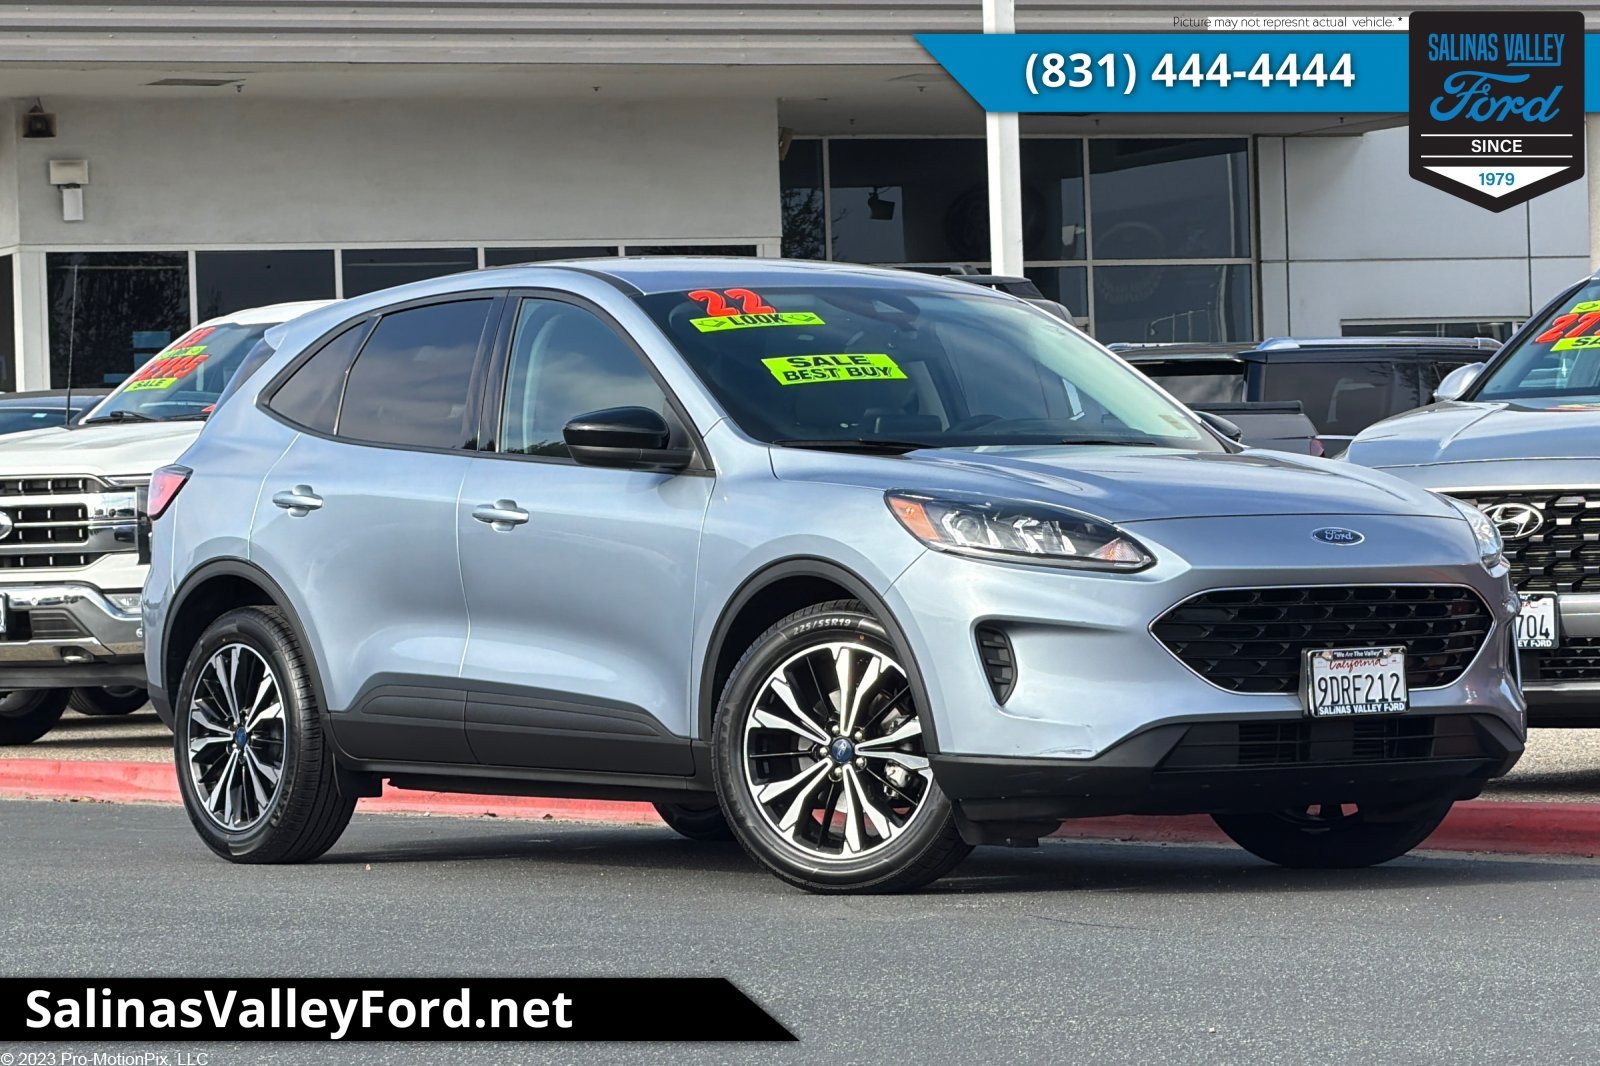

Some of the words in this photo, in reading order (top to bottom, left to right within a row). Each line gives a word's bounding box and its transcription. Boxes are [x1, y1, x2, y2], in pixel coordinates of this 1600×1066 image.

[688, 288, 777, 317] 22
[727, 313, 786, 326] LOOK
[1535, 310, 1600, 343] 27
[786, 355, 872, 368] SALE
[783, 367, 841, 381] BEST
[848, 366, 892, 378] BUY
[133, 379, 167, 389] SALE
[1325, 529, 1354, 541] Ford
[793, 618, 852, 635] 225/55R19
[1517, 614, 1551, 639] 704
[1530, 639, 1553, 648] FORD
[1330, 658, 1388, 672] California
[1317, 672, 1402, 706] 9DRF212
[1319, 705, 1352, 715] SALINAS
[1353, 703, 1382, 714] VALLEY
[1383, 702, 1405, 712] FORD
